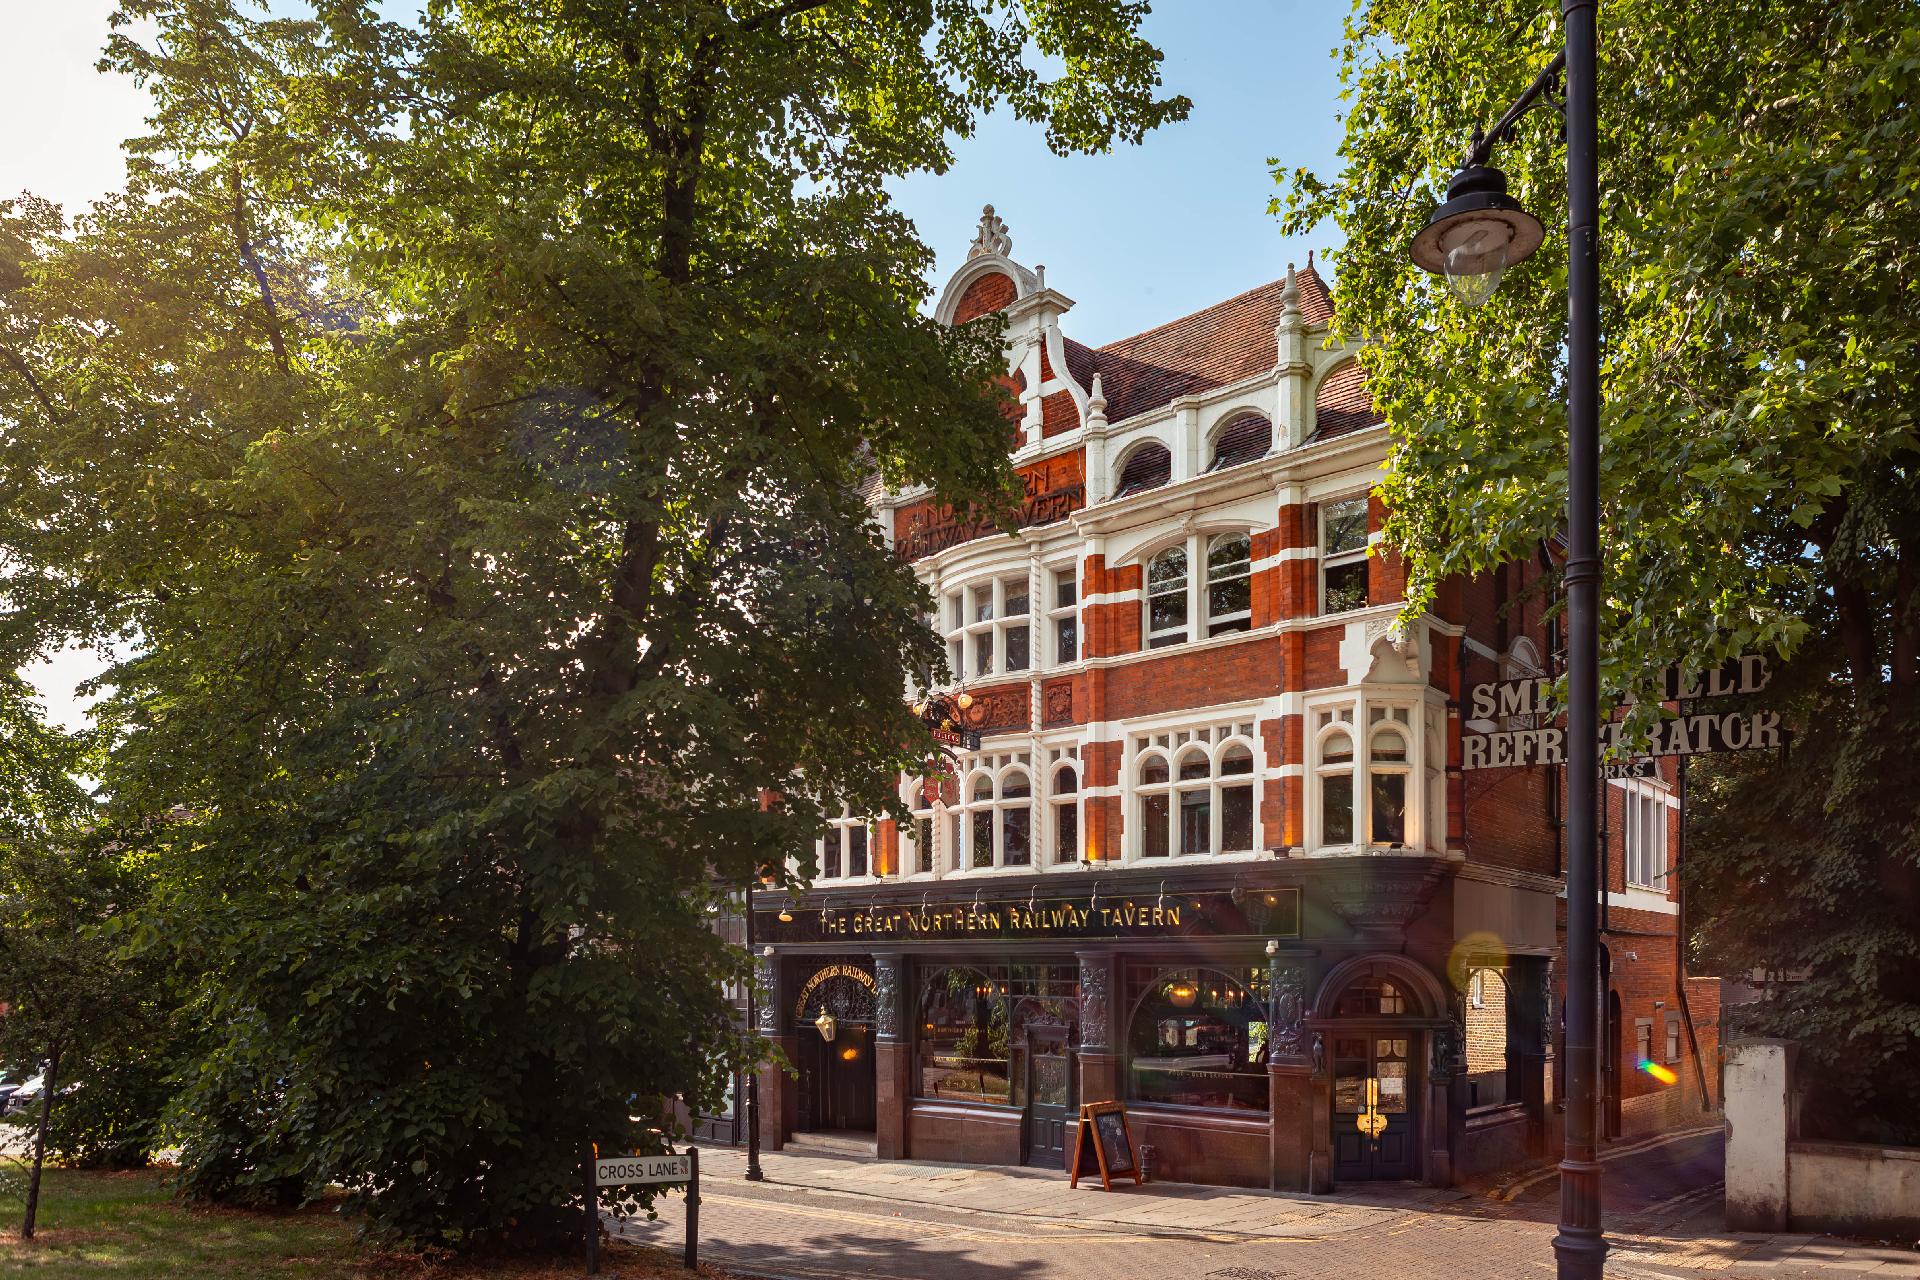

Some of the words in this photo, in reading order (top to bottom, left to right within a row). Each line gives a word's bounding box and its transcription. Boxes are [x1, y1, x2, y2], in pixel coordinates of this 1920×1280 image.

[819, 917, 846, 934] THE
[853, 915, 901, 933] GREAT
[908, 912, 1000, 931] NORTHERN
[1009, 909, 1089, 929] RAILWAY
[1100, 906, 1181, 926] TAVERN
[806, 965, 840, 993] NORTHERN
[842, 965, 873, 987] RAILWAY
[598, 1164, 644, 1179] CROSS
[648, 1161, 678, 1176] LANE
